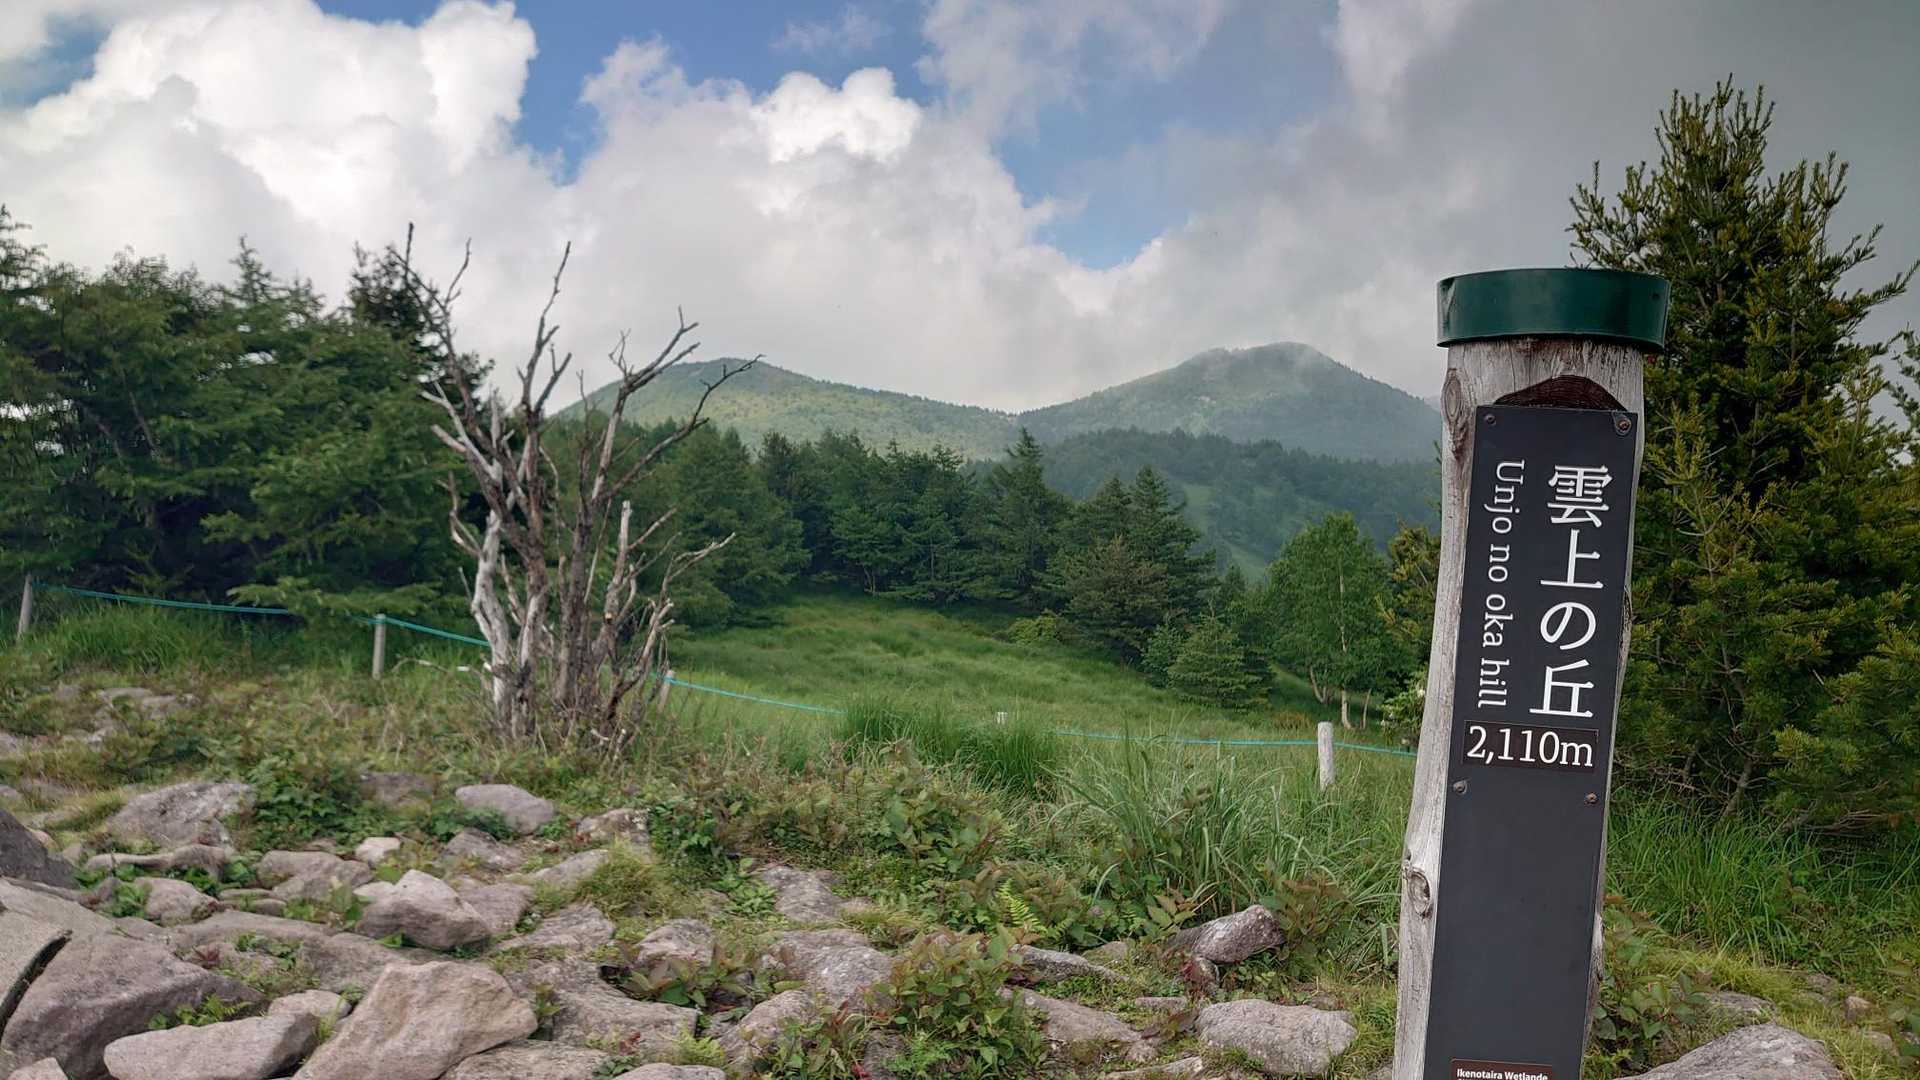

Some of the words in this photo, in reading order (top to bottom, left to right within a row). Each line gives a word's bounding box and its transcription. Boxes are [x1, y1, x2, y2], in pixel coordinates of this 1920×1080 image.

[1485, 460, 1525, 534] Unjo
[1488, 543, 1510, 583] no
[1529, 464, 1613, 718] 雲上の丘
[1482, 593, 1514, 648] oka
[1477, 657, 1510, 709] hill
[1466, 725, 1593, 767] 2,110m
[1456, 1068, 1502, 1080] Ikenotaira
